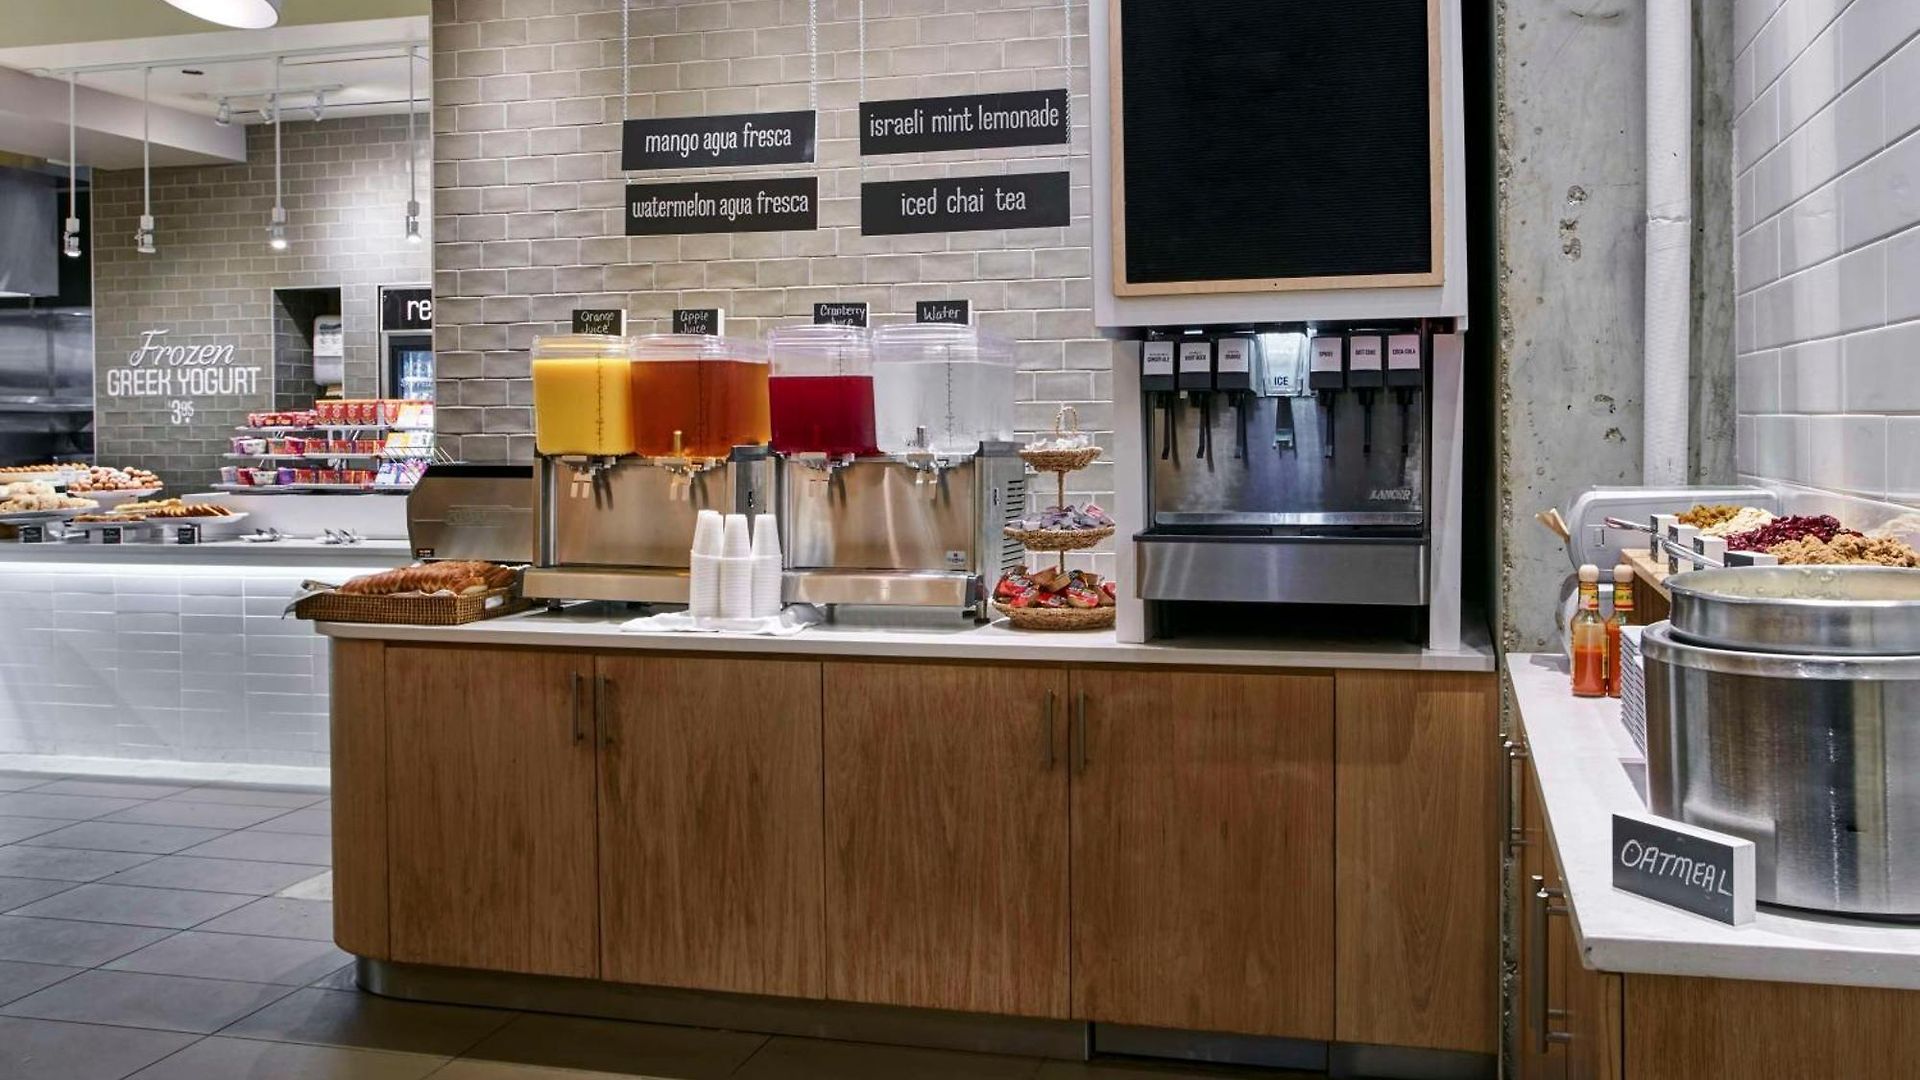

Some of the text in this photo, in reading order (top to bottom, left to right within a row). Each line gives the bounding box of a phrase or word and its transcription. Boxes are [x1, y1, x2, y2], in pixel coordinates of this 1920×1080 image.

[870, 98, 1059, 137] israeli mint lemonade
[645, 122, 792, 158] mango agua fresca
[632, 190, 809, 221] watermelon agua fresca
[901, 186, 1026, 216] iced chai tea
[580, 311, 615, 326] Orange
[820, 304, 866, 321] Cranberry
[923, 306, 961, 321] Water
[128, 328, 236, 366] Frozen
[107, 367, 262, 396] GREEK YOGURT
[1274, 376, 1289, 386] ICE
[1621, 839, 1733, 897] OATMEAL
